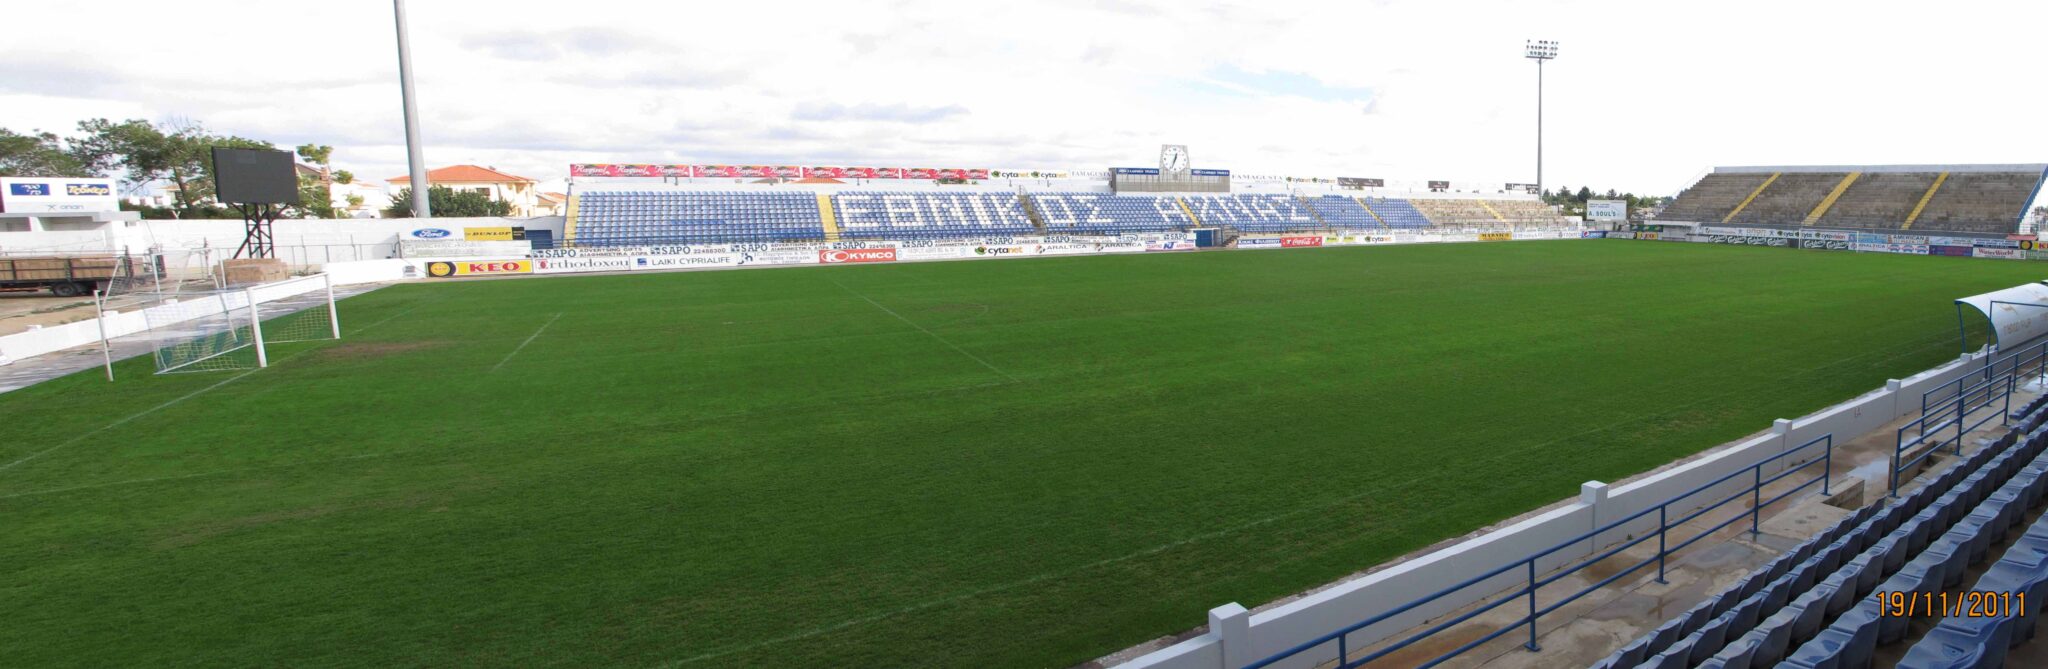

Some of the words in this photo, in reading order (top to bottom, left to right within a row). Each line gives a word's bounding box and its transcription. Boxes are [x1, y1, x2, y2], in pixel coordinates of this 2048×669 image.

[842, 241, 866, 249] SAPO
[993, 237, 1014, 245] SAPO
[662, 246, 691, 255] SAPO
[741, 244, 768, 252] SAPO
[988, 247, 1023, 256] cytanet
[545, 249, 576, 258] SAPO
[849, 251, 894, 259] KYMCO
[680, 257, 731, 265] CYPRIALIFE
[469, 262, 520, 272] KEO
